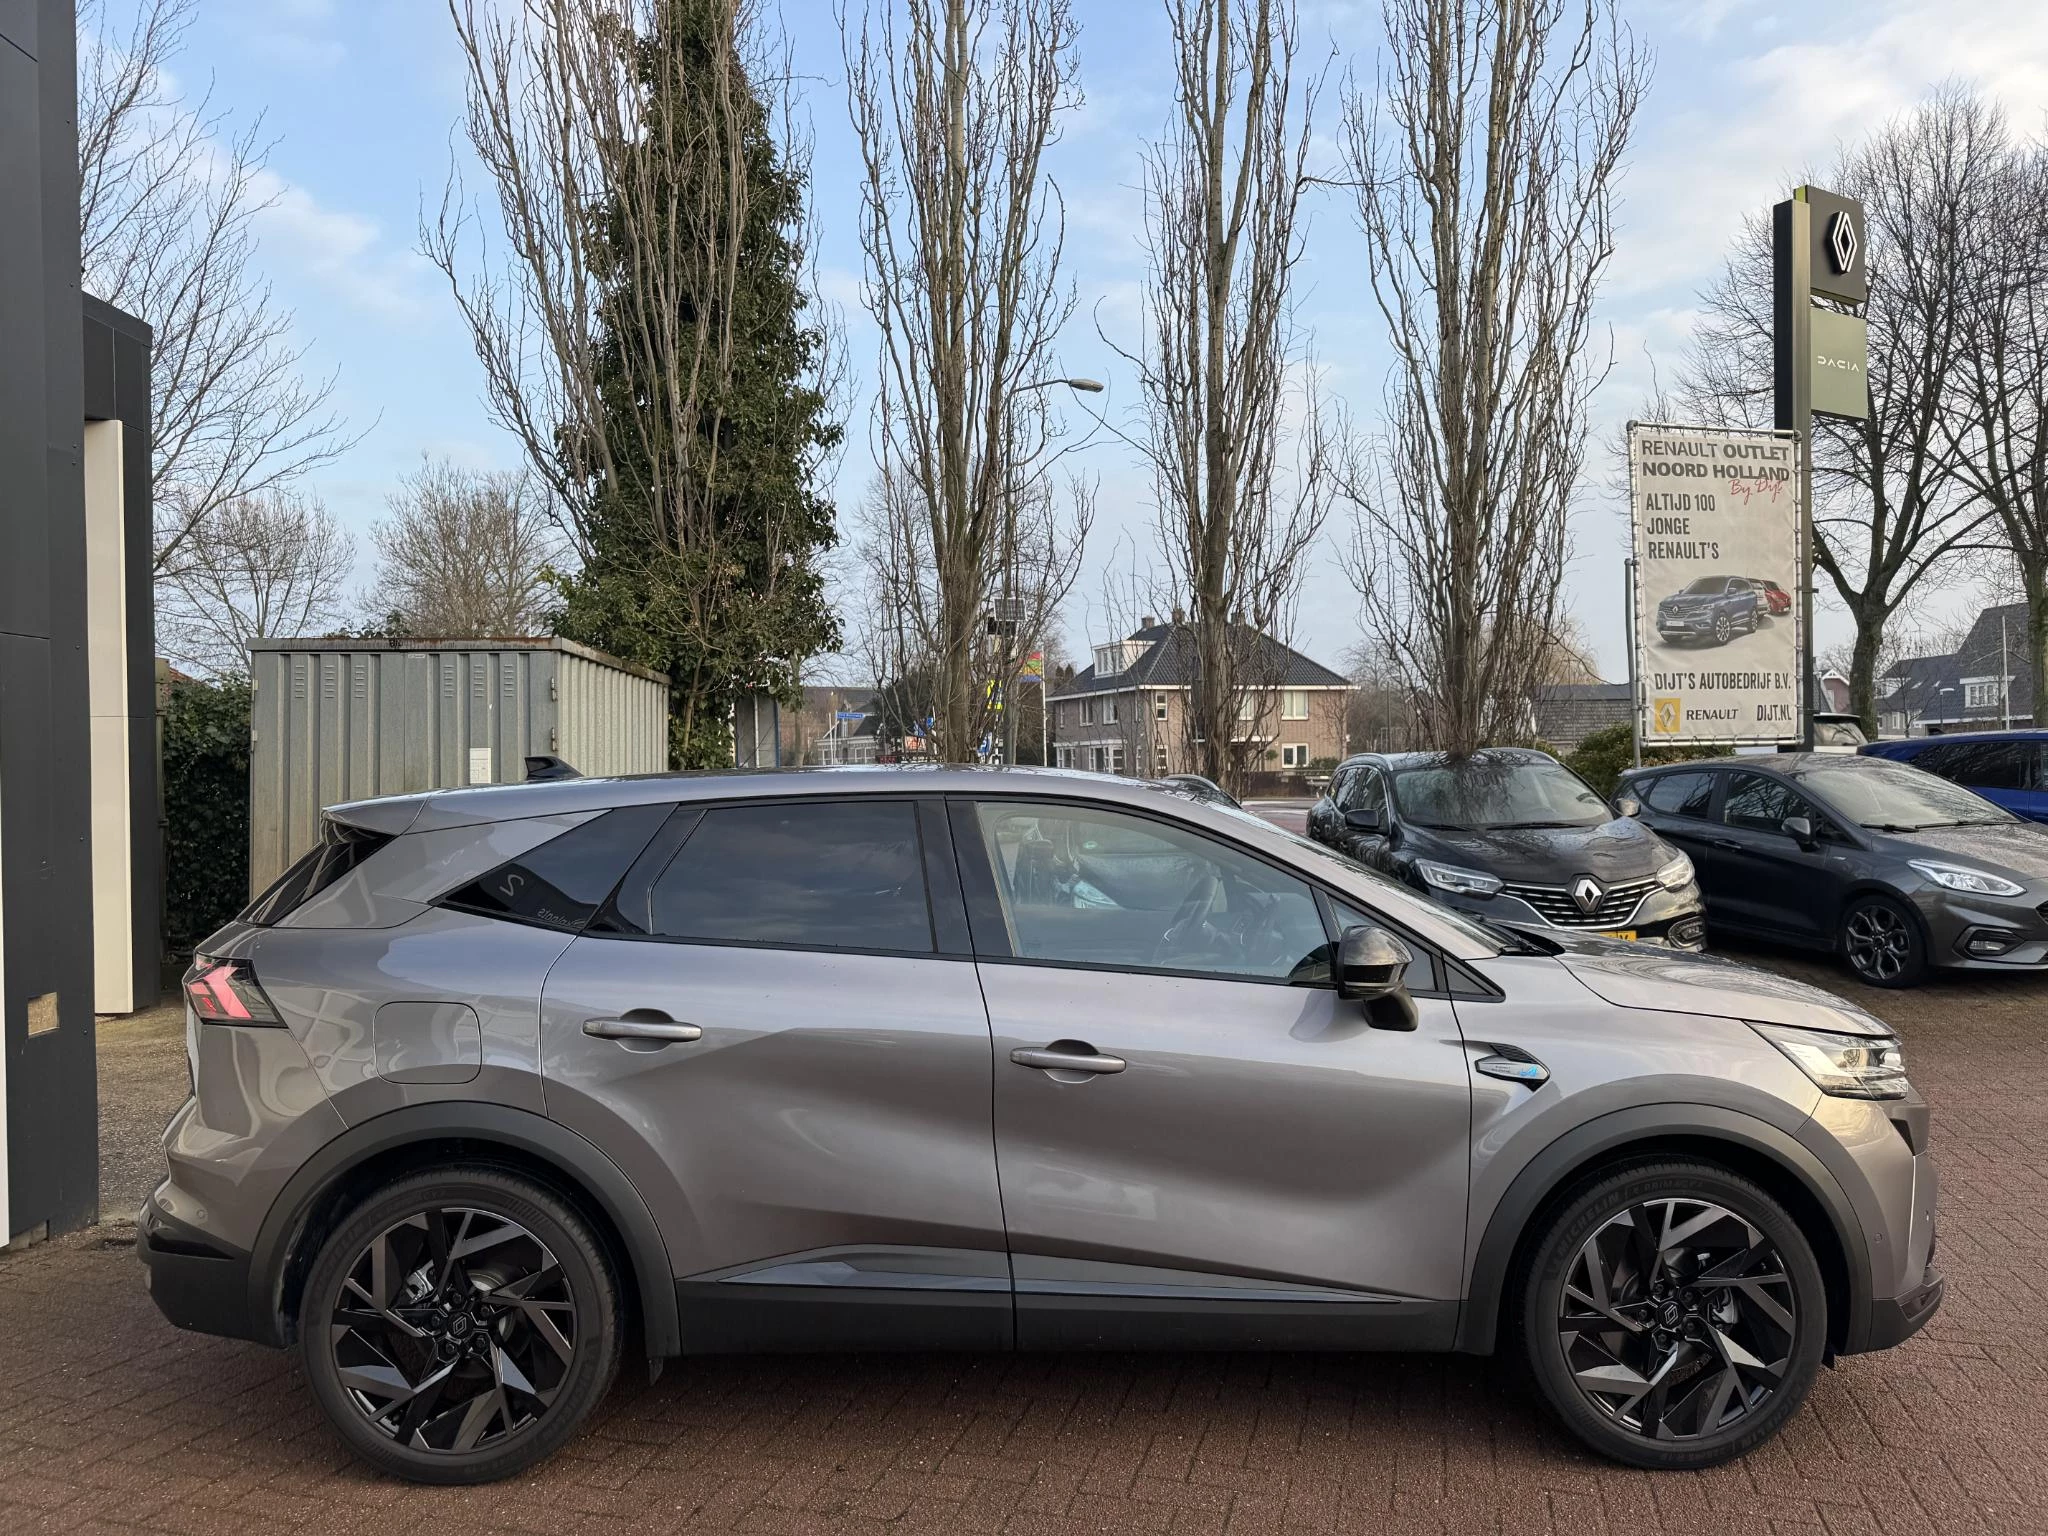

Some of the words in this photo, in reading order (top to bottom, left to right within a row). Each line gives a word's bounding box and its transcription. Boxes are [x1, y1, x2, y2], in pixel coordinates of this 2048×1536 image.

[1817, 355, 1860, 373] DACIA
[1641, 440, 1717, 458] RENAULT
[1723, 444, 1789, 461] OUTLET
[1642, 462, 1708, 478] NOORD
[1713, 464, 1790, 482] HOLLAND
[1728, 479, 1753, 505] By
[1646, 493, 1691, 511] ALTIJD
[1694, 494, 1716, 511] 100
[1647, 517, 1690, 534] JONGE
[1648, 541, 1720, 559] RENAULT'S
[1654, 672, 1696, 690] DIJT'S
[1699, 672, 1772, 690] AUTOBEDRIJF
[1774, 672, 1791, 690] B.V.
[1686, 709, 1739, 721] RENAULT
[1756, 704, 1792, 721] DIJT.NL
